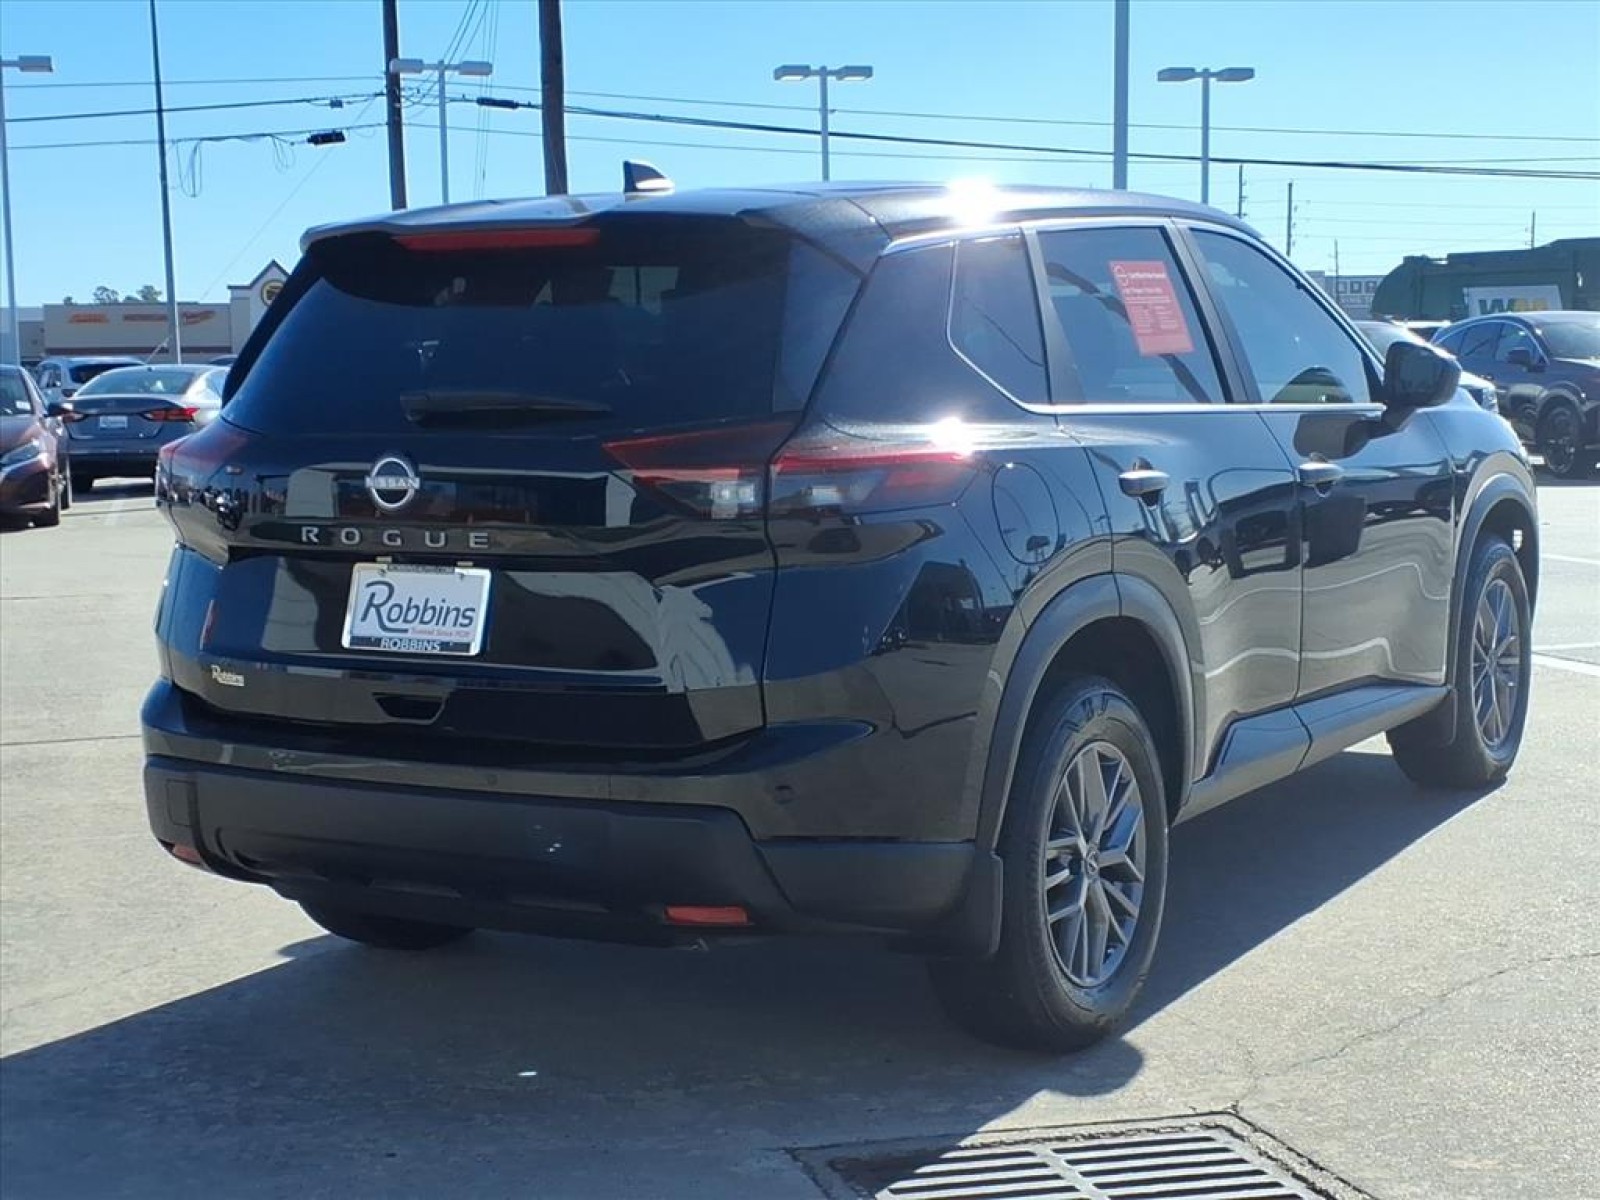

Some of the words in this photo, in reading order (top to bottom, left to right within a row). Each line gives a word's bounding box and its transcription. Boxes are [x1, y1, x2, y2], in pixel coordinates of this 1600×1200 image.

[365, 475, 420, 489] NISSAN
[301, 526, 489, 549] ROGUE
[361, 580, 476, 634] Robbins
[380, 637, 440, 652] ROBBINS
